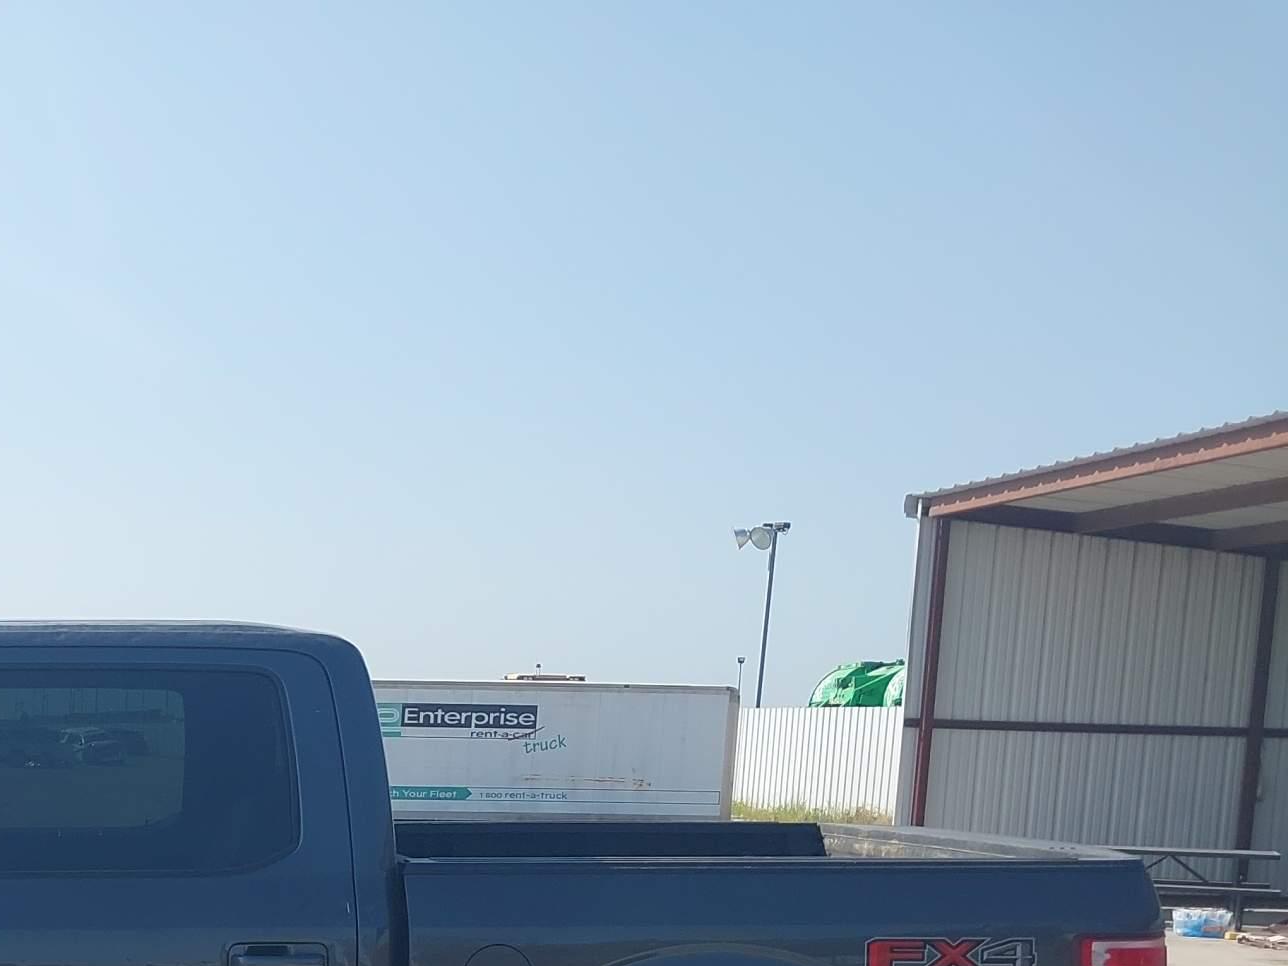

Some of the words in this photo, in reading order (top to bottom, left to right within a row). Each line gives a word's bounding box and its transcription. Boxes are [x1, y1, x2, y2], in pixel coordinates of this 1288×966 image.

[403, 707, 536, 729] Enterprise
[522, 734, 567, 754] truck
[402, 789, 427, 799] Your
[430, 790, 457, 799] Fleet
[504, 791, 568, 801] rent-a-truck
